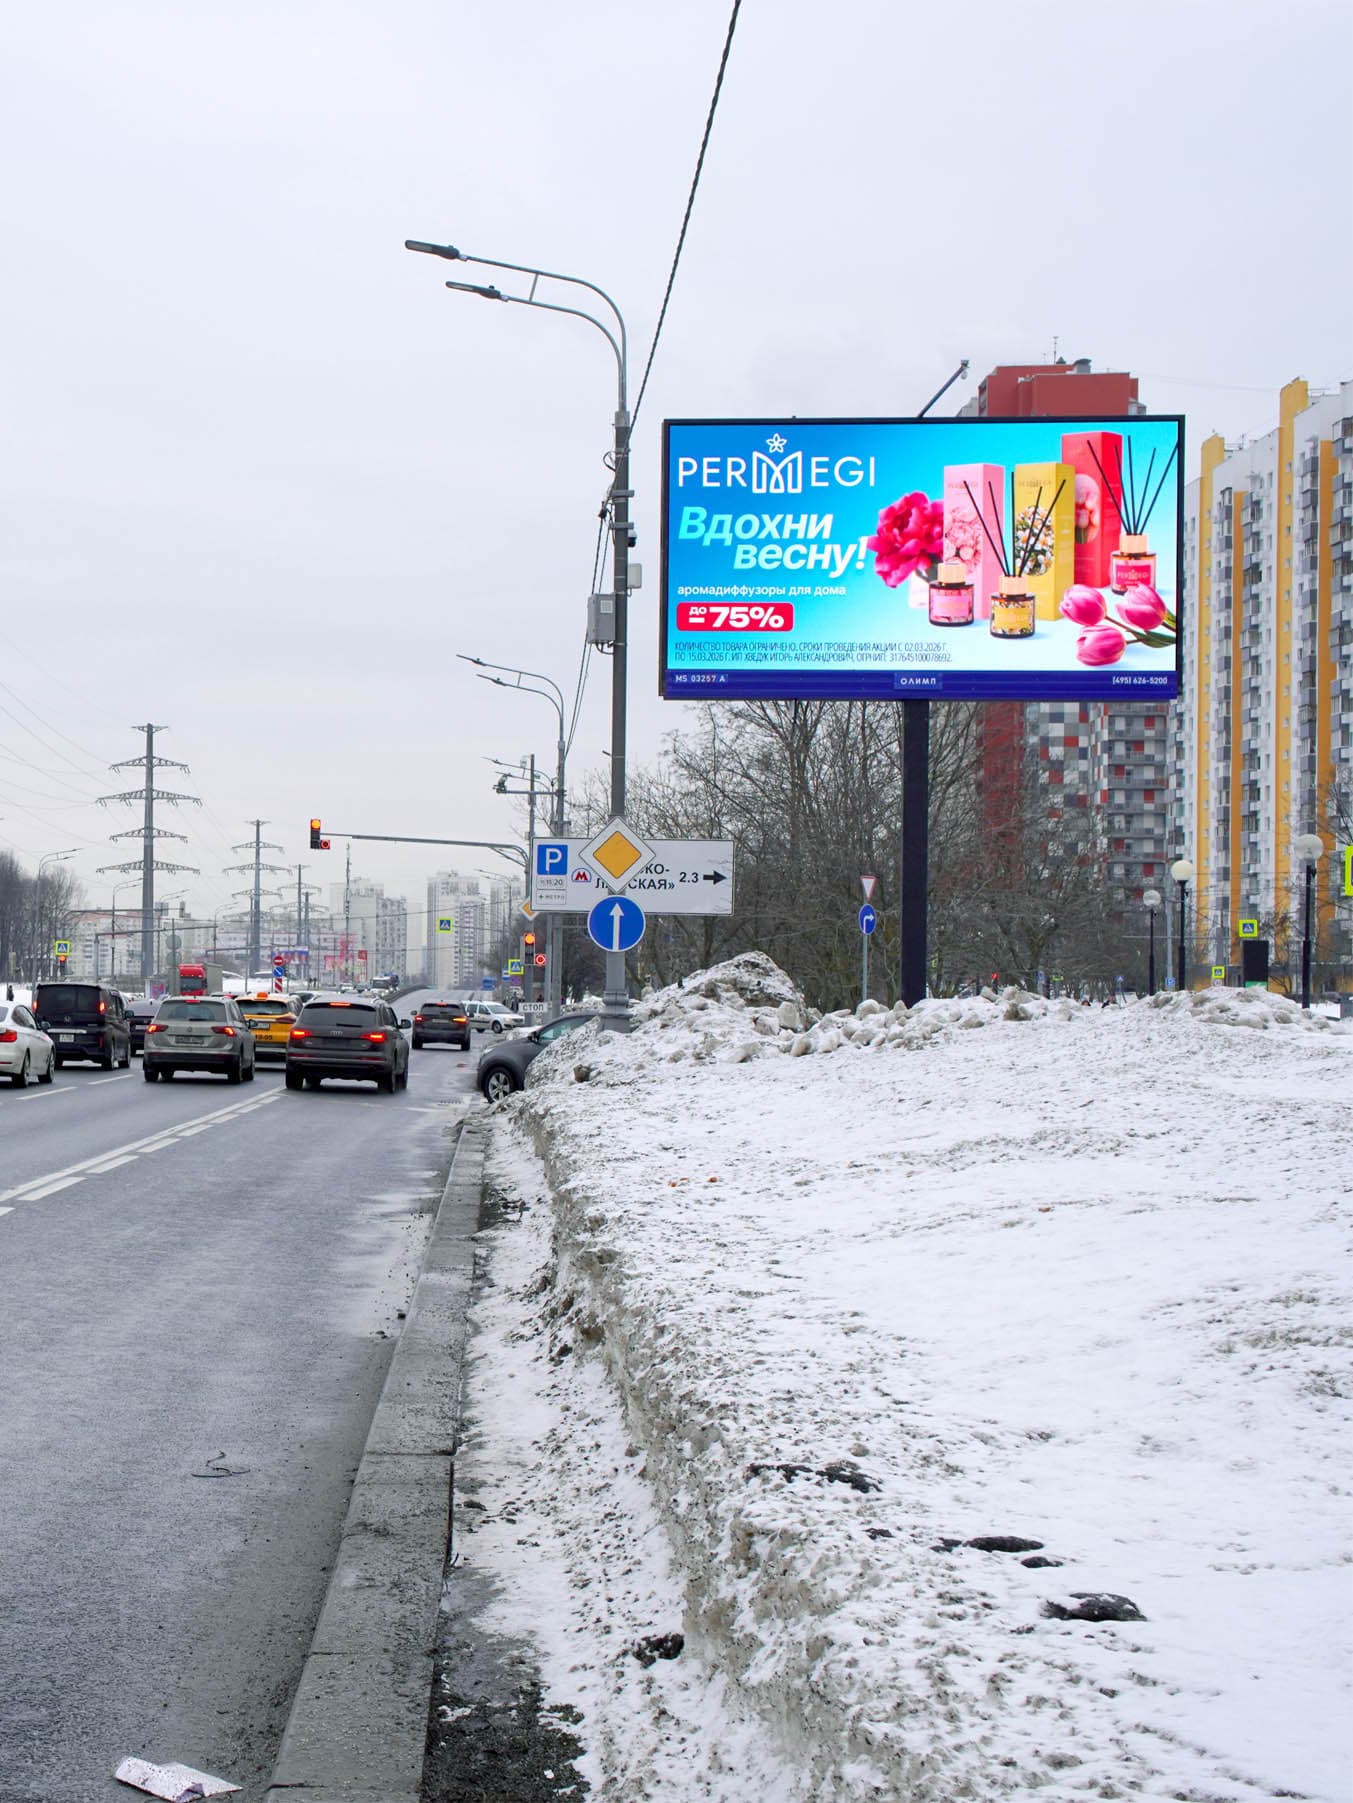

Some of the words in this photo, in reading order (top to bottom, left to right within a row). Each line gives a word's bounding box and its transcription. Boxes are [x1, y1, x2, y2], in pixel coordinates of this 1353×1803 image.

[677, 450, 875, 493] PERMEGI
[678, 506, 834, 547] Вдохни
[733, 535, 869, 578] весну!
[677, 584, 786, 597] аромадиффузоры
[788, 585, 811, 596] для
[814, 585, 847, 596] дома
[688, 606, 708, 616] до
[675, 642, 720, 651] КОЛИЧЕСТВО
[722, 642, 747, 651] ТОВАРА
[799, 642, 822, 651] СРОКИ
[824, 642, 870, 651] ПРОВЕДЕНИЯ
[872, 642, 896, 651] АКЦИИ
[675, 652, 685, 662] ПО
[770, 652, 793, 662] ИГОРЬ
[900, 677, 936, 685] ОЛИМП
[679, 872, 699, 884] 2.3
